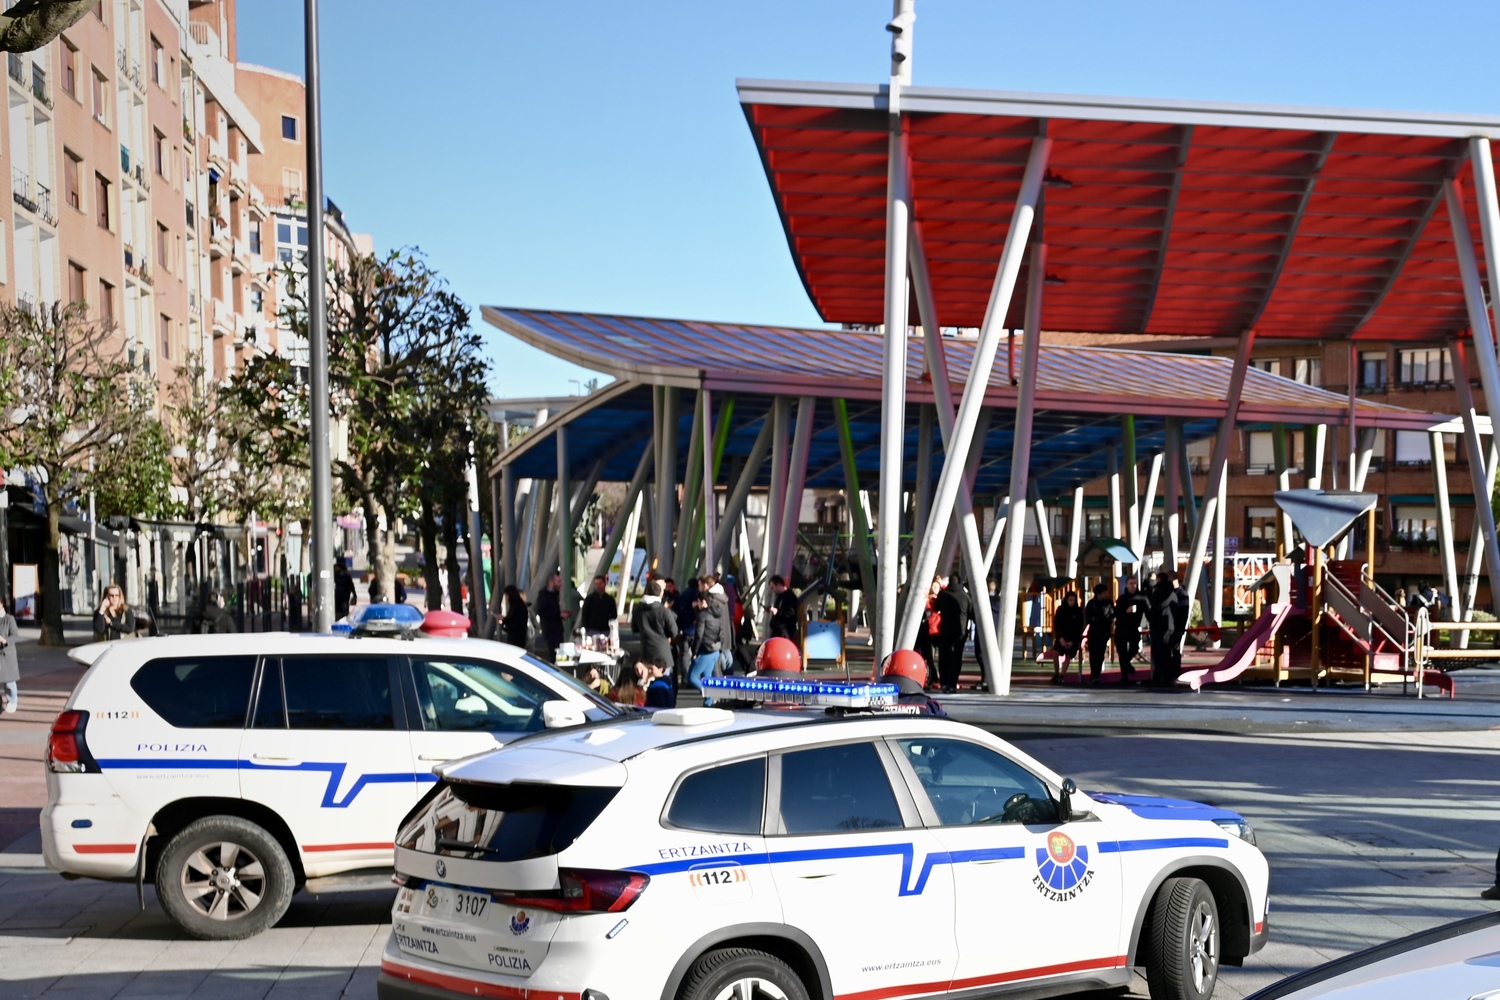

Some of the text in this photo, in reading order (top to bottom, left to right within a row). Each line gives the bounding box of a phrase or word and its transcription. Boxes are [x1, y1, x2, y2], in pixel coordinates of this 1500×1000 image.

[107, 711, 128, 719] 112
[137, 743, 208, 752] POLIZIA
[658, 841, 753, 860] ERTZAINTZA
[703, 870, 732, 886] 112
[1032, 868, 1096, 902] ERTZAINTZA
[456, 893, 488, 917] 3107
[421, 924, 477, 943] www.ertzaintza.eus
[397, 933, 440, 955] ERTZAINTZA
[488, 952, 532, 971] POLIZIA
[861, 957, 942, 973] www.ertzaintza.eus
